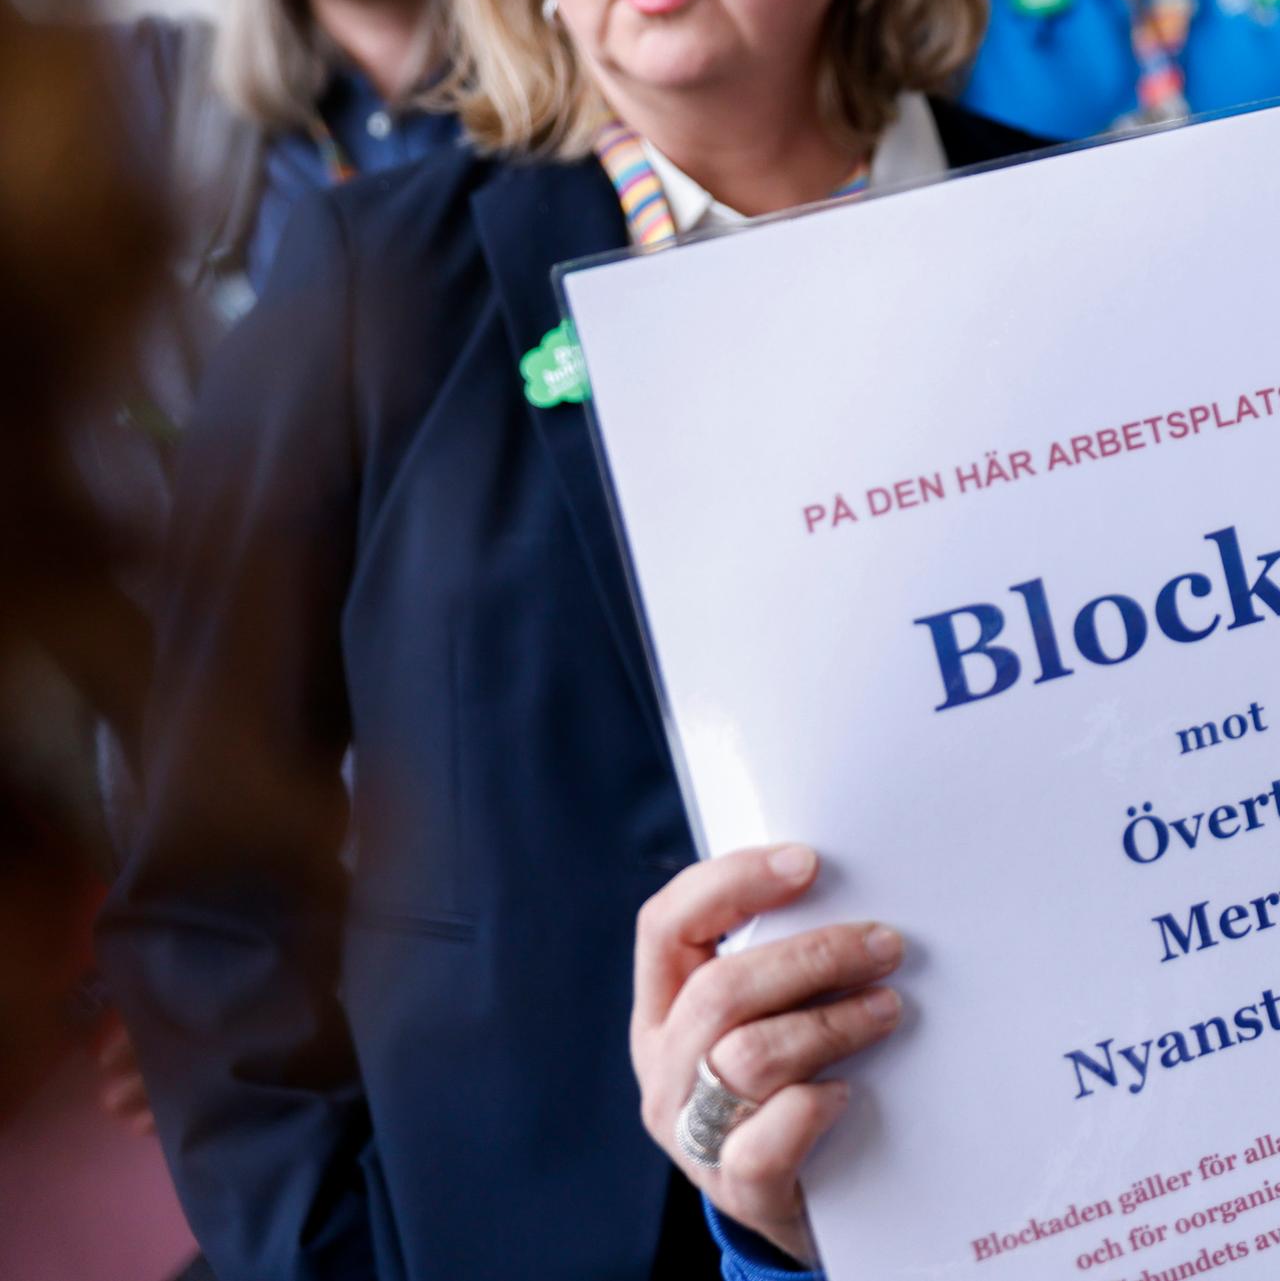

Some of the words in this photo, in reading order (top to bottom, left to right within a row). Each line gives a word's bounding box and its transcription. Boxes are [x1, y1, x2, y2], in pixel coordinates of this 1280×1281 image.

[803, 492, 858, 535] PÅ
[866, 469, 947, 517] DEN
[955, 445, 1036, 494] HÄR
[1175, 700, 1269, 756] mot
[970, 1199, 1114, 1263] Blockaden
[1117, 1168, 1194, 1216] gäller
[1197, 1152, 1237, 1182] för
[1075, 1236, 1125, 1272] och
[1127, 1223, 1168, 1253] för
